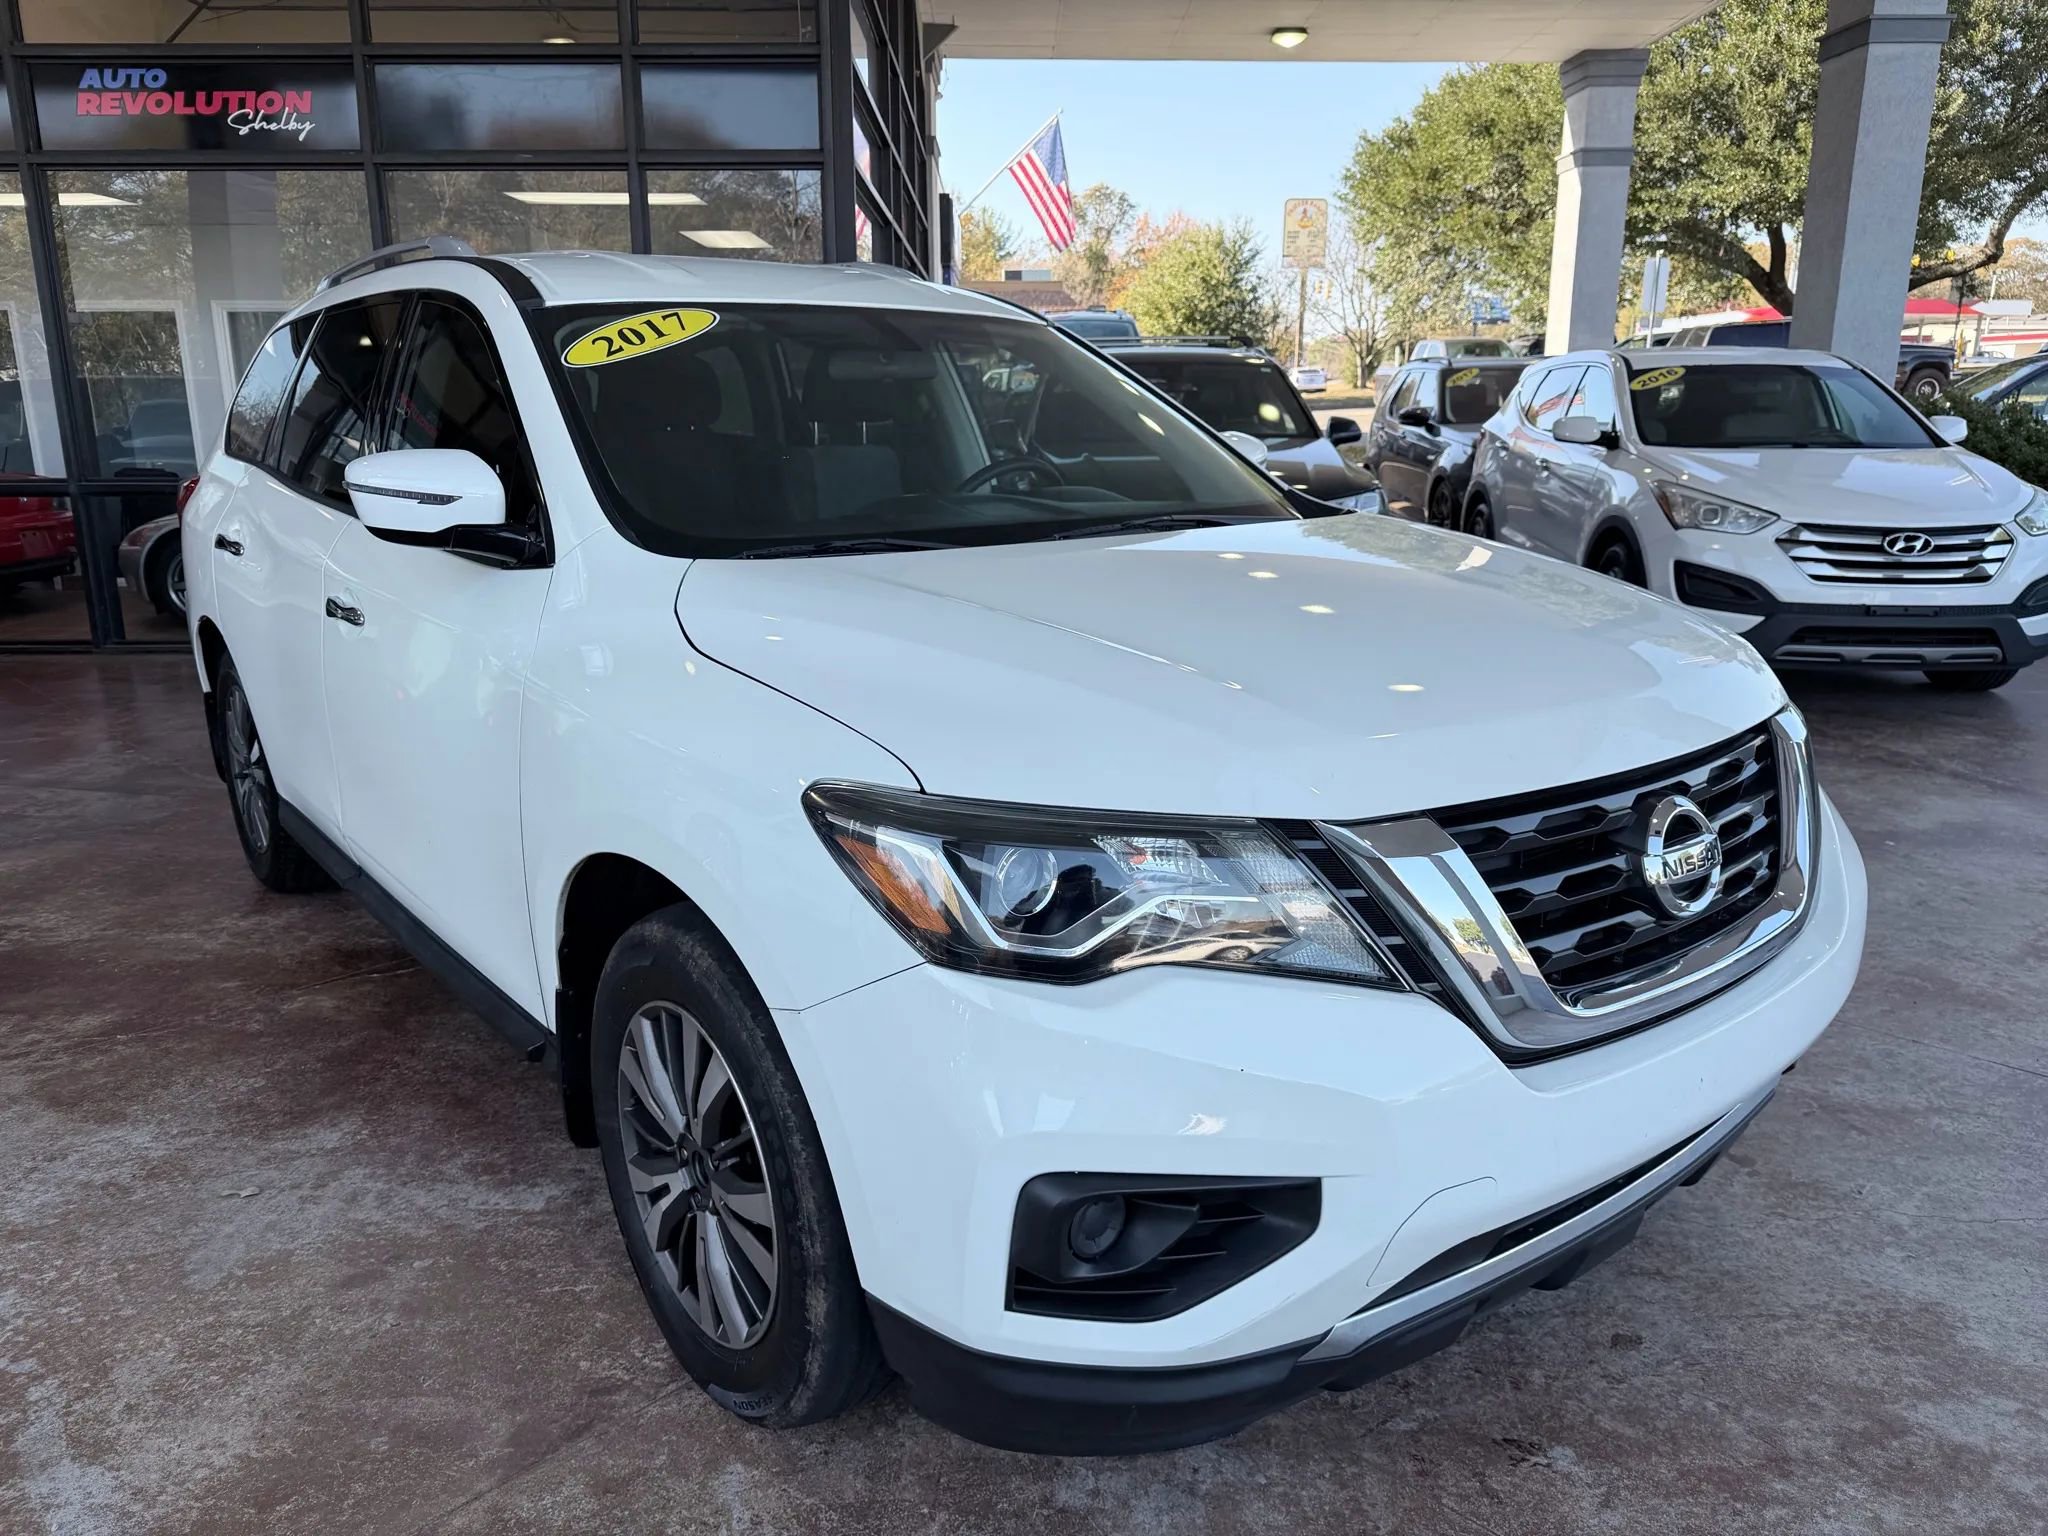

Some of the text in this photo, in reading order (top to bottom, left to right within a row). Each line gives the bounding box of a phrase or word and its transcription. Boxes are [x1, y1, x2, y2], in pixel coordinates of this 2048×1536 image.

[79, 68, 167, 89] AUTO
[76, 90, 312, 116] REVOLUTION
[227, 107, 316, 141] Shelby
[591, 312, 686, 357] 2017
[1637, 368, 1679, 388] 2016
